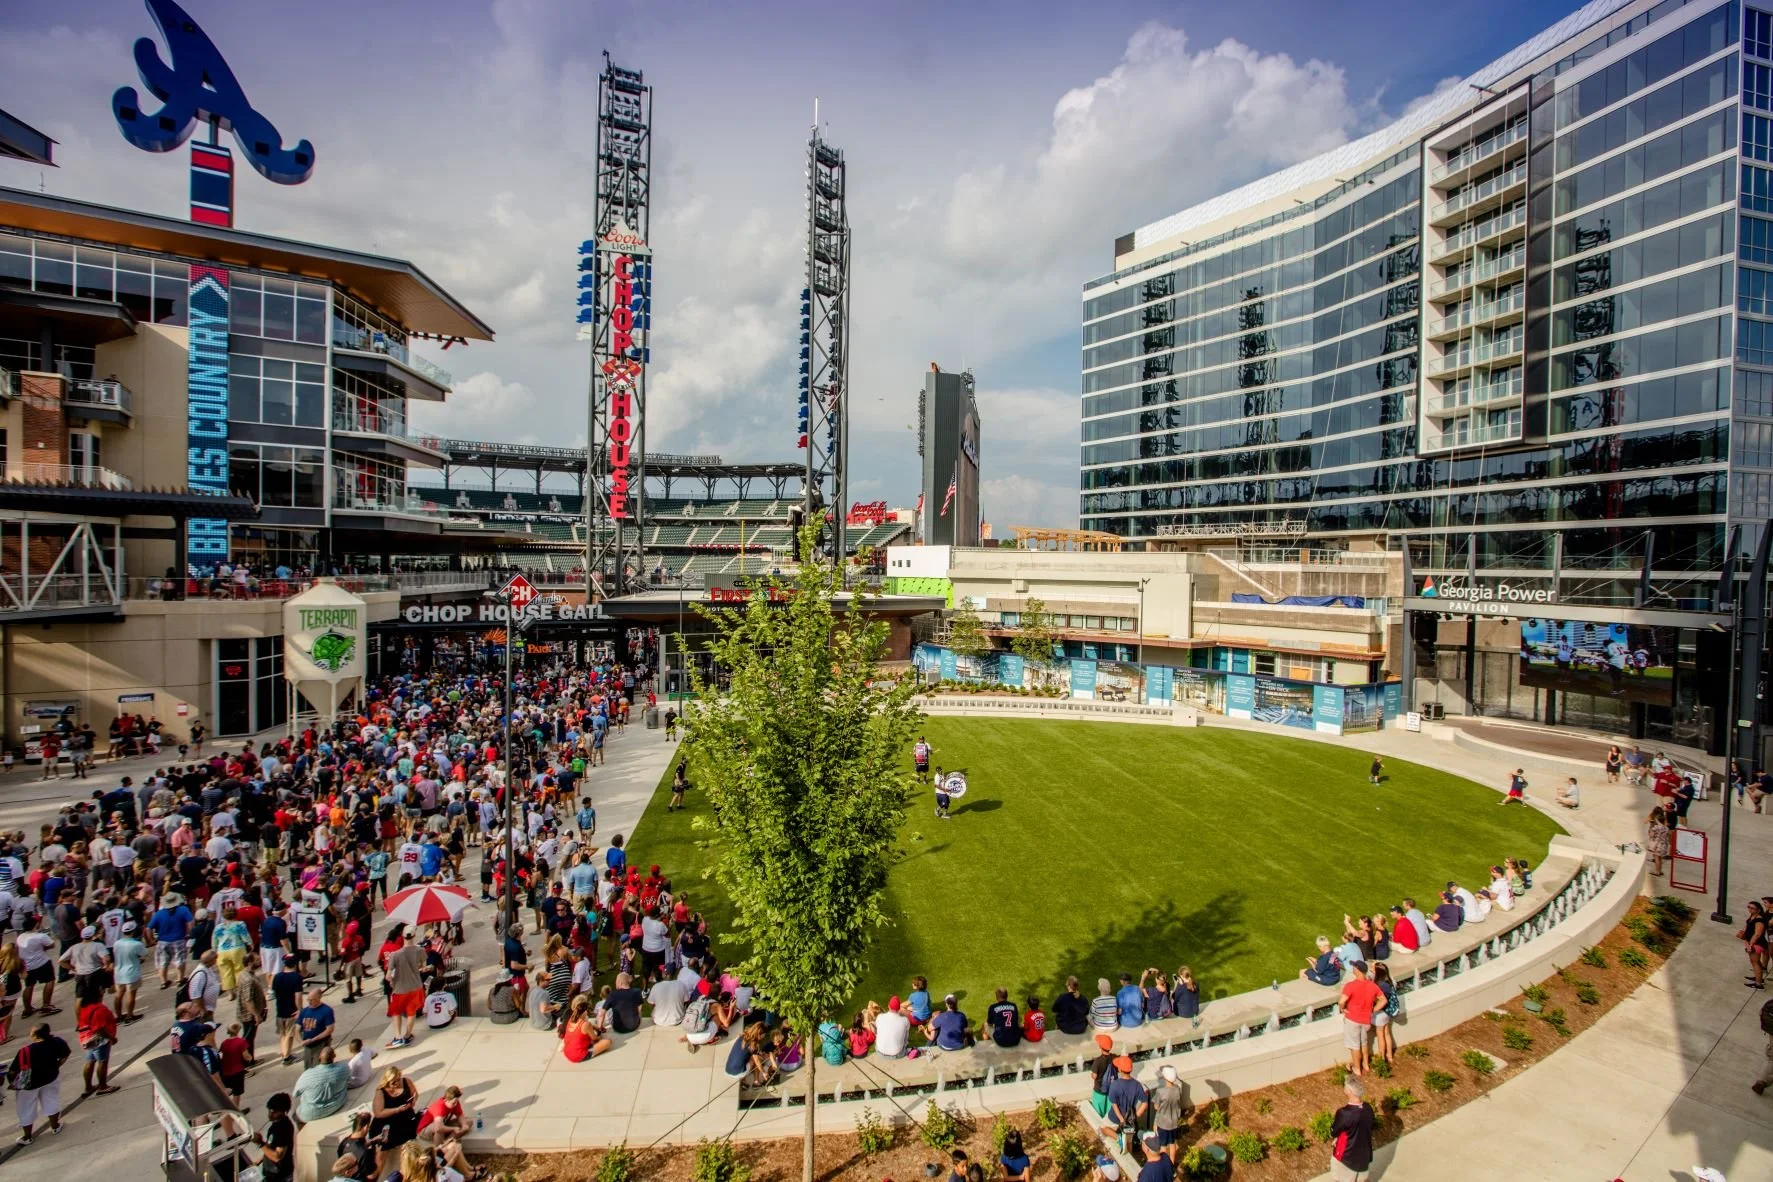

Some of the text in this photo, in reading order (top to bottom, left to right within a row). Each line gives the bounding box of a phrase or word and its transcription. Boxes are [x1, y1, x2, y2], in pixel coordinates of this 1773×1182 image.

[604, 228, 644, 245] Coors
[611, 242, 637, 252] LIGHT
[612, 256, 633, 355] CHOP
[186, 307, 229, 554] BRVES COUNTRY
[609, 393, 631, 519] HOUSE
[1438, 582, 1557, 603] Georgia Power
[405, 604, 473, 623] CHOP
[479, 603, 553, 622] HOUSE
[1449, 602, 1510, 614] PAVILION
[298, 608, 358, 631] TERRAPIN
[403, 852, 418, 863] 29
[109, 917, 119, 927] 5
[433, 1002, 442, 1014] 5
[1003, 1011, 1012, 1027] 7
